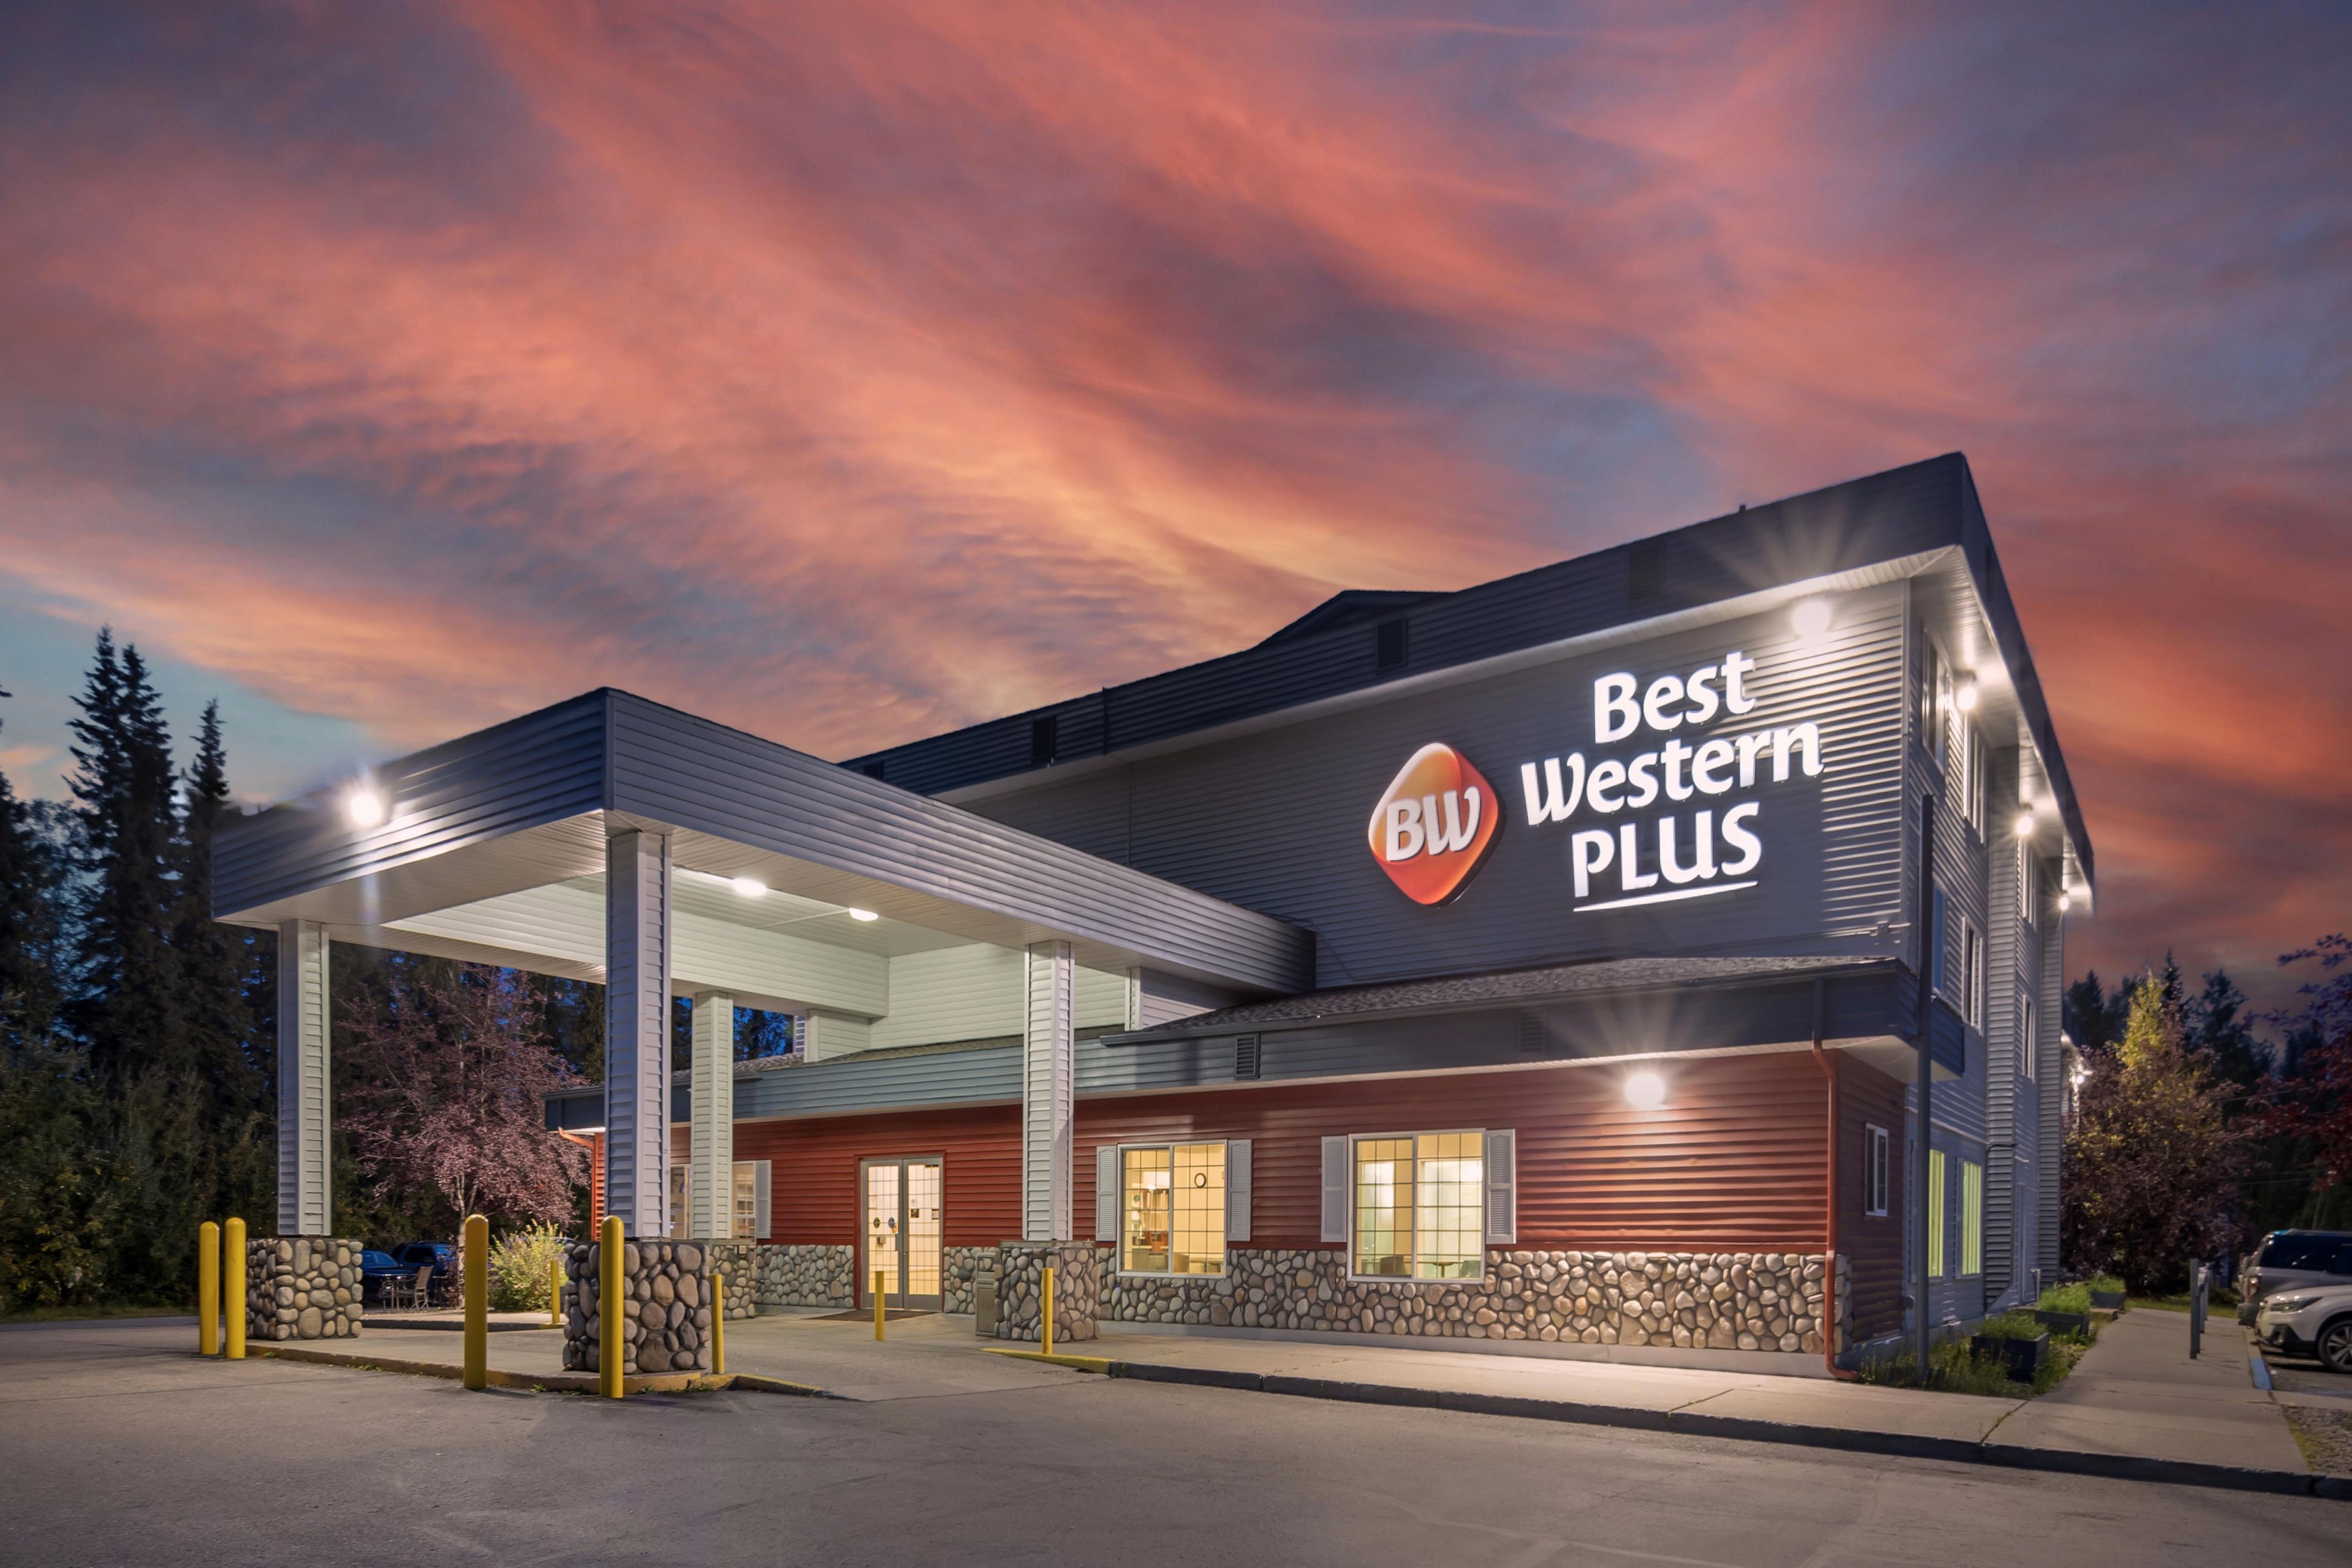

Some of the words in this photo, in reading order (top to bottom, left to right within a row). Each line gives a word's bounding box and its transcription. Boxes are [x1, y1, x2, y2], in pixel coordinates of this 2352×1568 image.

[1594, 650, 1756, 744] Best
[1521, 722, 1825, 826] Western
[1385, 786, 1481, 861] BW
[1572, 802, 1762, 898] PLUS
